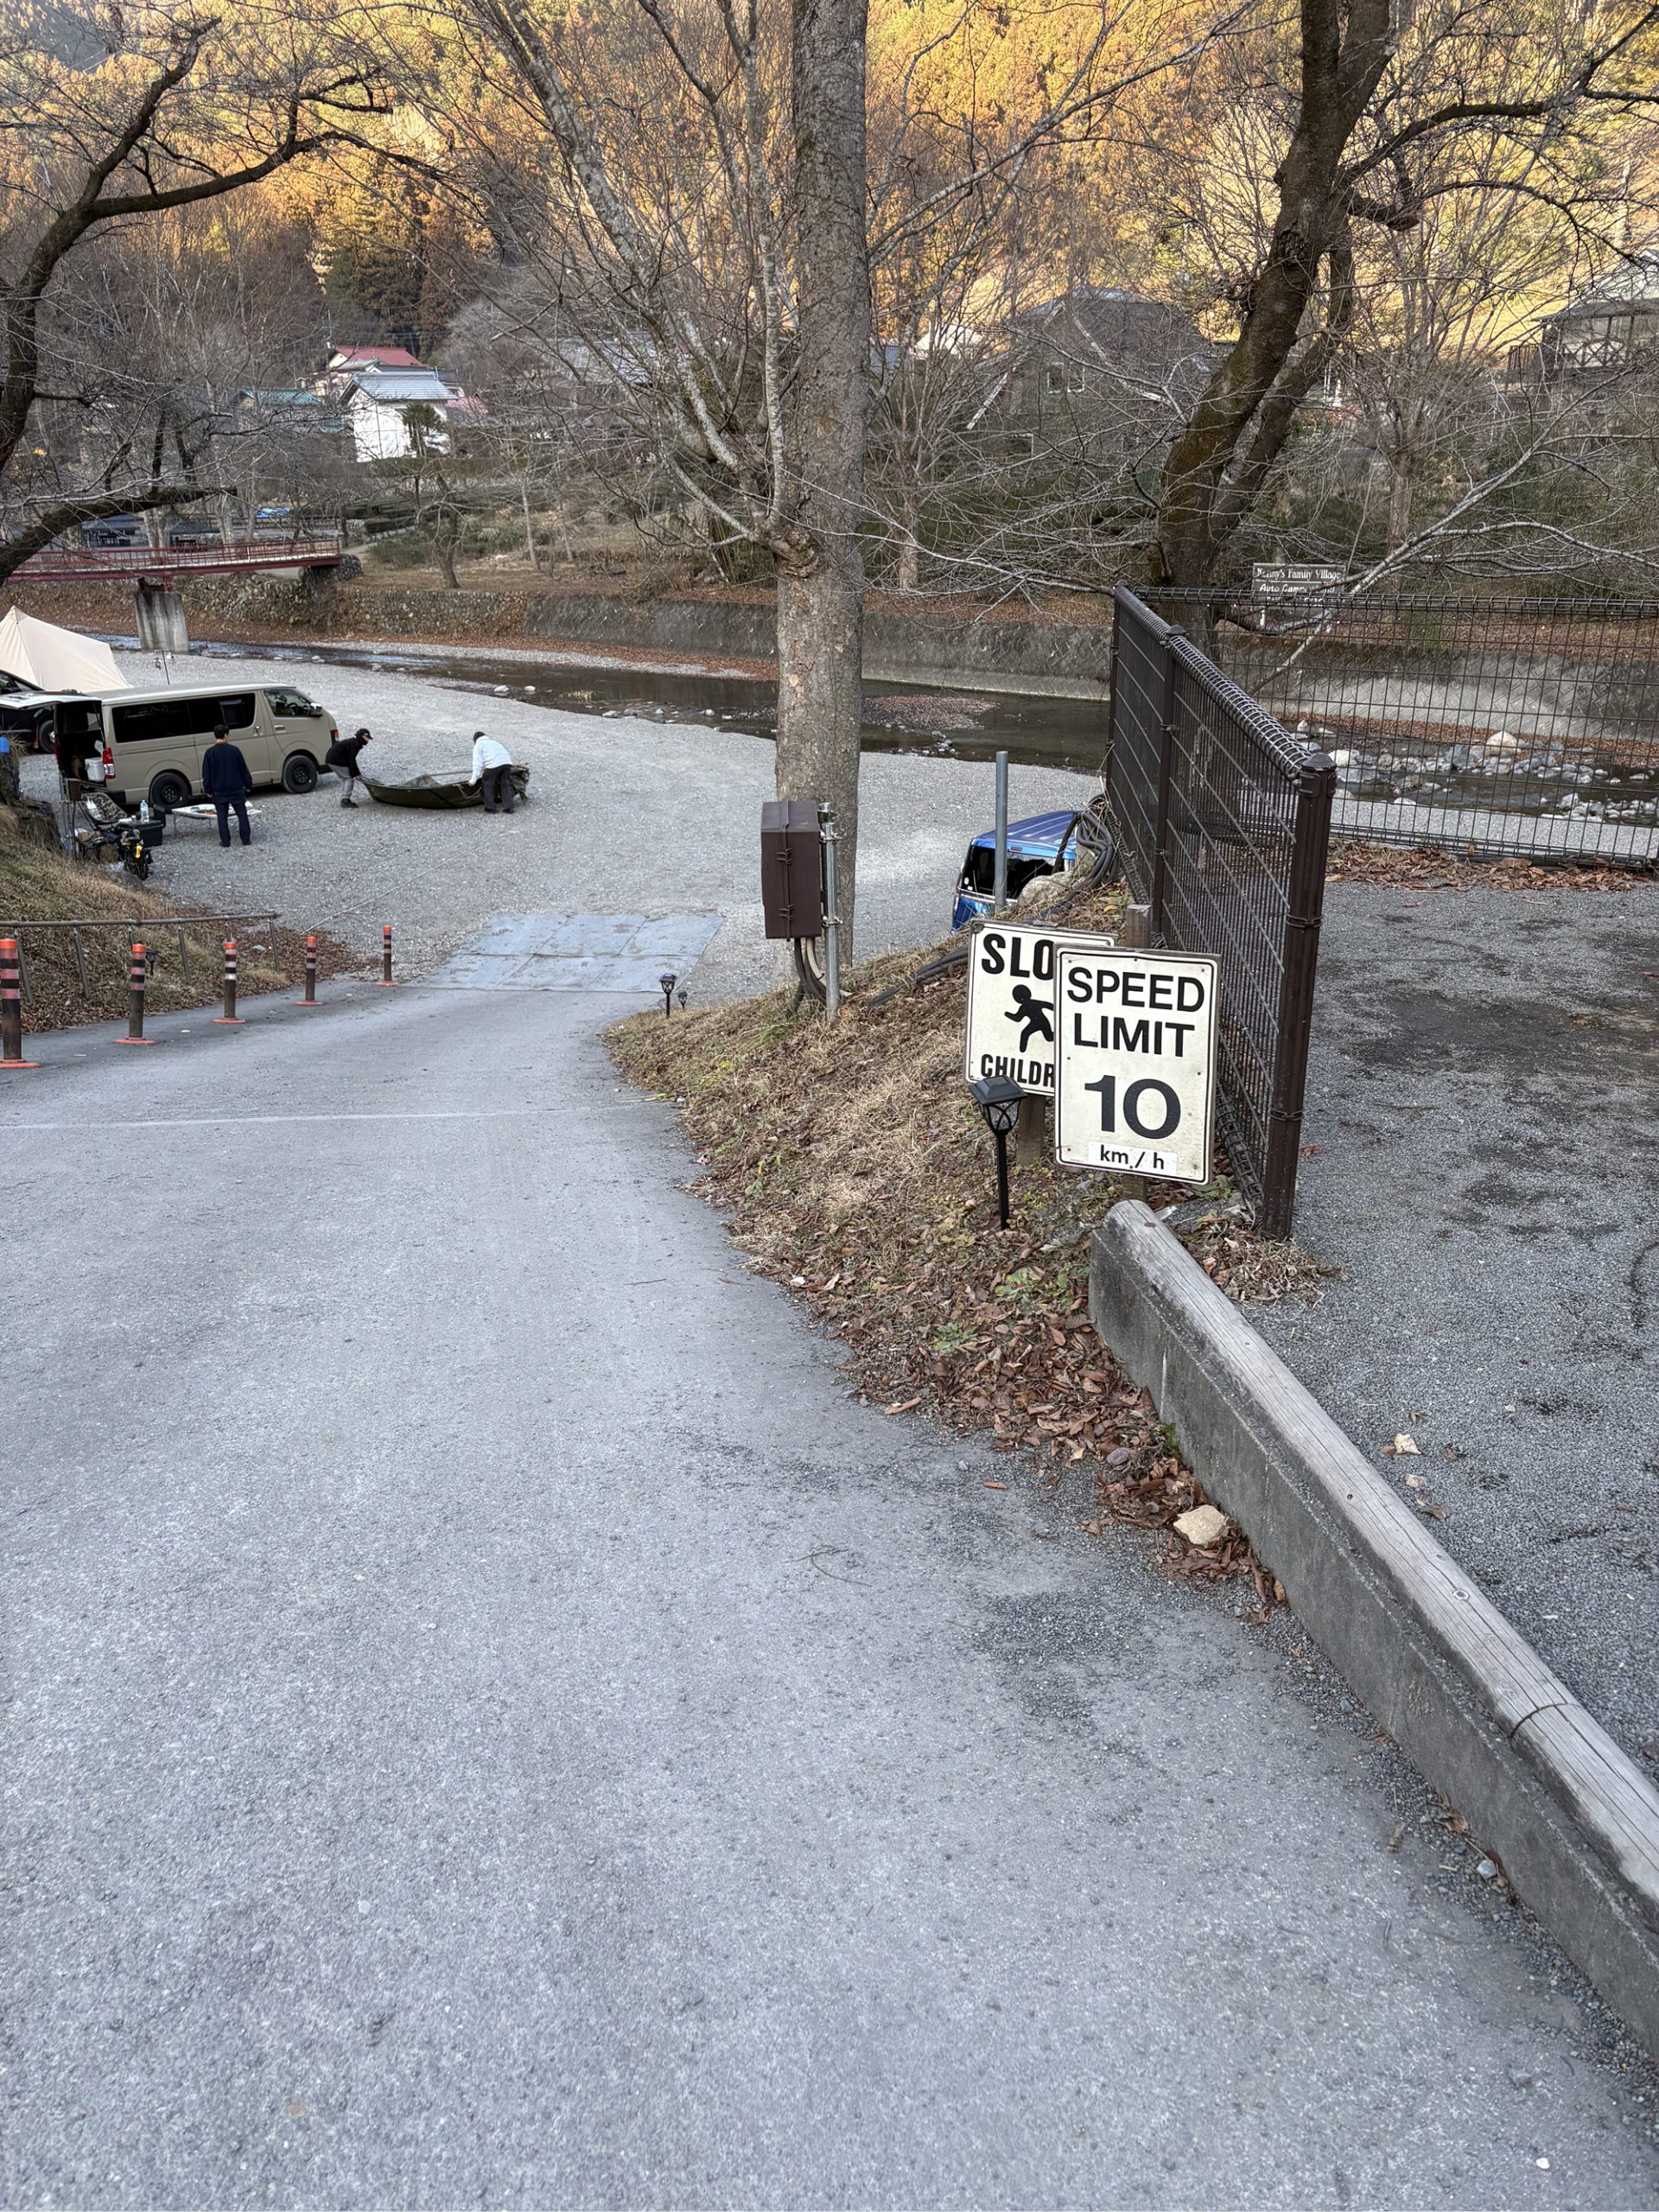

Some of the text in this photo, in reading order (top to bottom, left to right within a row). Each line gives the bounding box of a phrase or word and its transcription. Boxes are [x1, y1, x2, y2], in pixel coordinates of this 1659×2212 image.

[1260, 583, 1280, 593] Auto
[1287, 569, 1313, 581] Family
[1316, 569, 1341, 581] Village
[981, 933, 1054, 981] SLO
[1067, 966, 1205, 1013] SPEED
[1074, 1013, 1195, 1058] LIMIT
[981, 1053, 1054, 1088] CHILDR
[1084, 1074, 1181, 1140] 10
